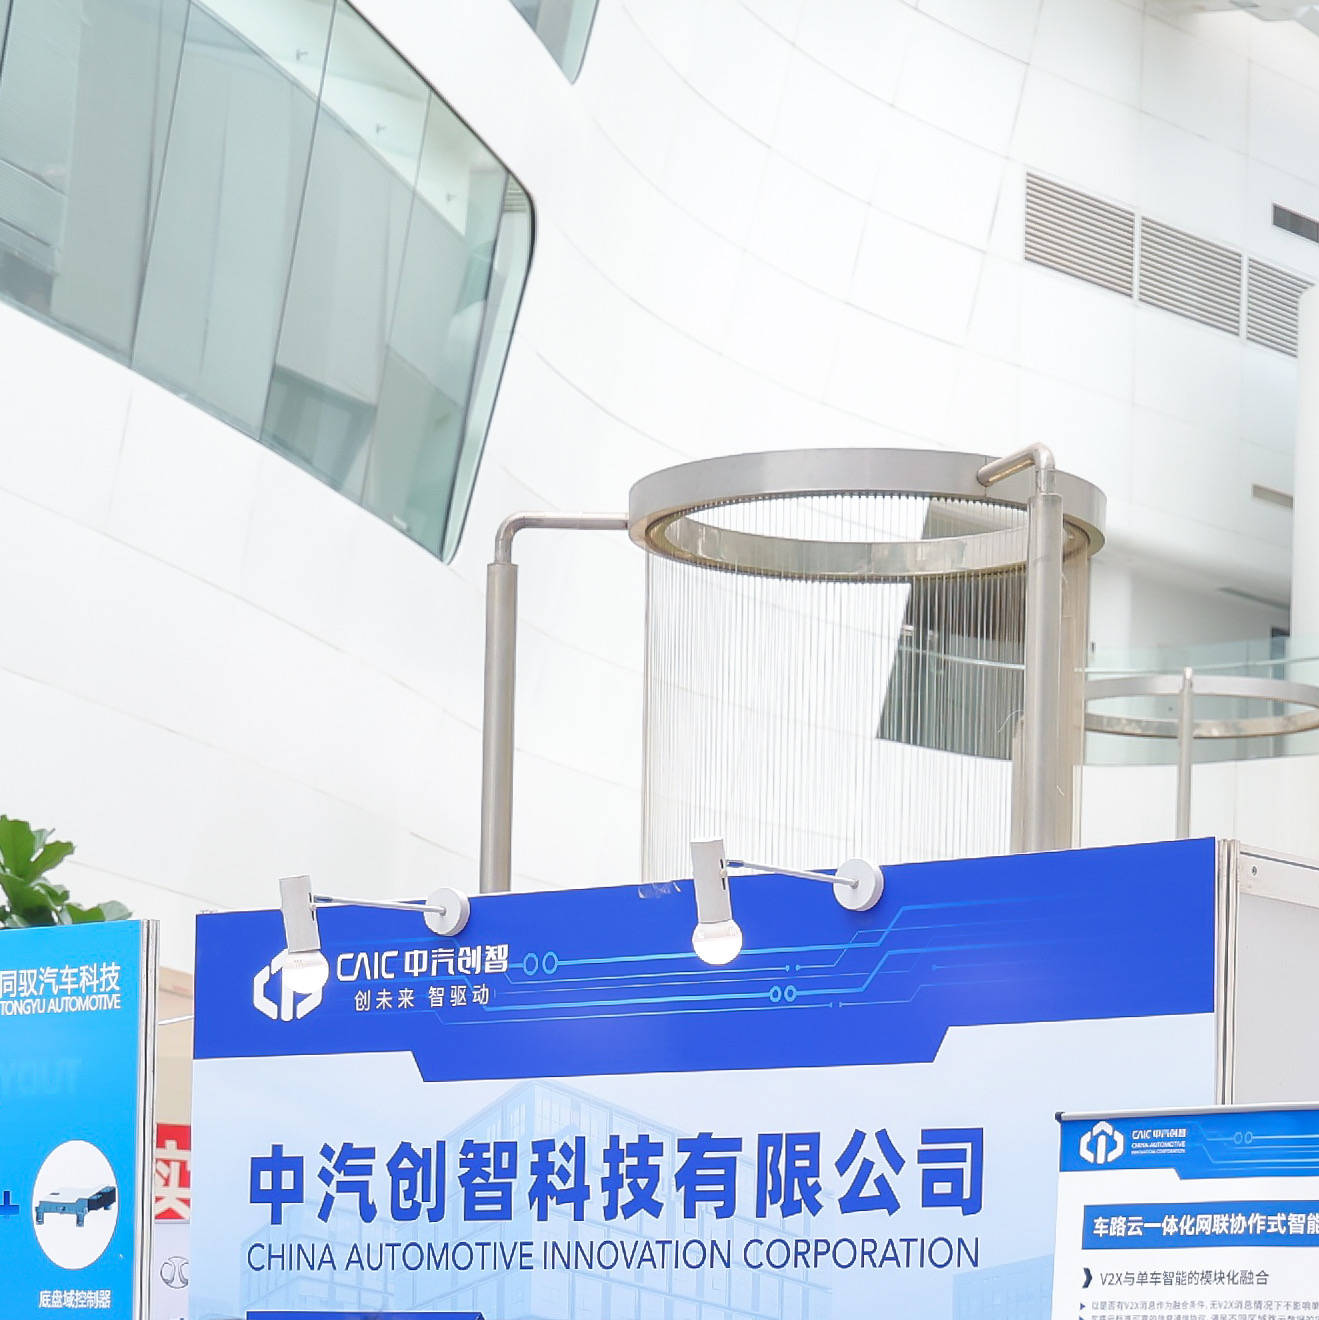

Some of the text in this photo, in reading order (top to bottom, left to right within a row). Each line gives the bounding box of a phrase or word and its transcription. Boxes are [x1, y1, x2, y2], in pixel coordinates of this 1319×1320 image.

[336, 943, 510, 982] CAIC 中汽创智
[0, 961, 121, 998] 同驭汽车科技
[0, 994, 121, 1016] TONGYU AUTOMOTIVE
[354, 983, 490, 1012] 创未来 智驱动
[248, 1126, 985, 1227] 中汽创智科技有限公司
[246, 1235, 980, 1273] CHINA AUTOMOTIVE INNOVATION CORPORATION
[1099, 1269, 1270, 1287] V2X与单车智能的模块化融合
[38, 1288, 112, 1309] 底盘域控制器
